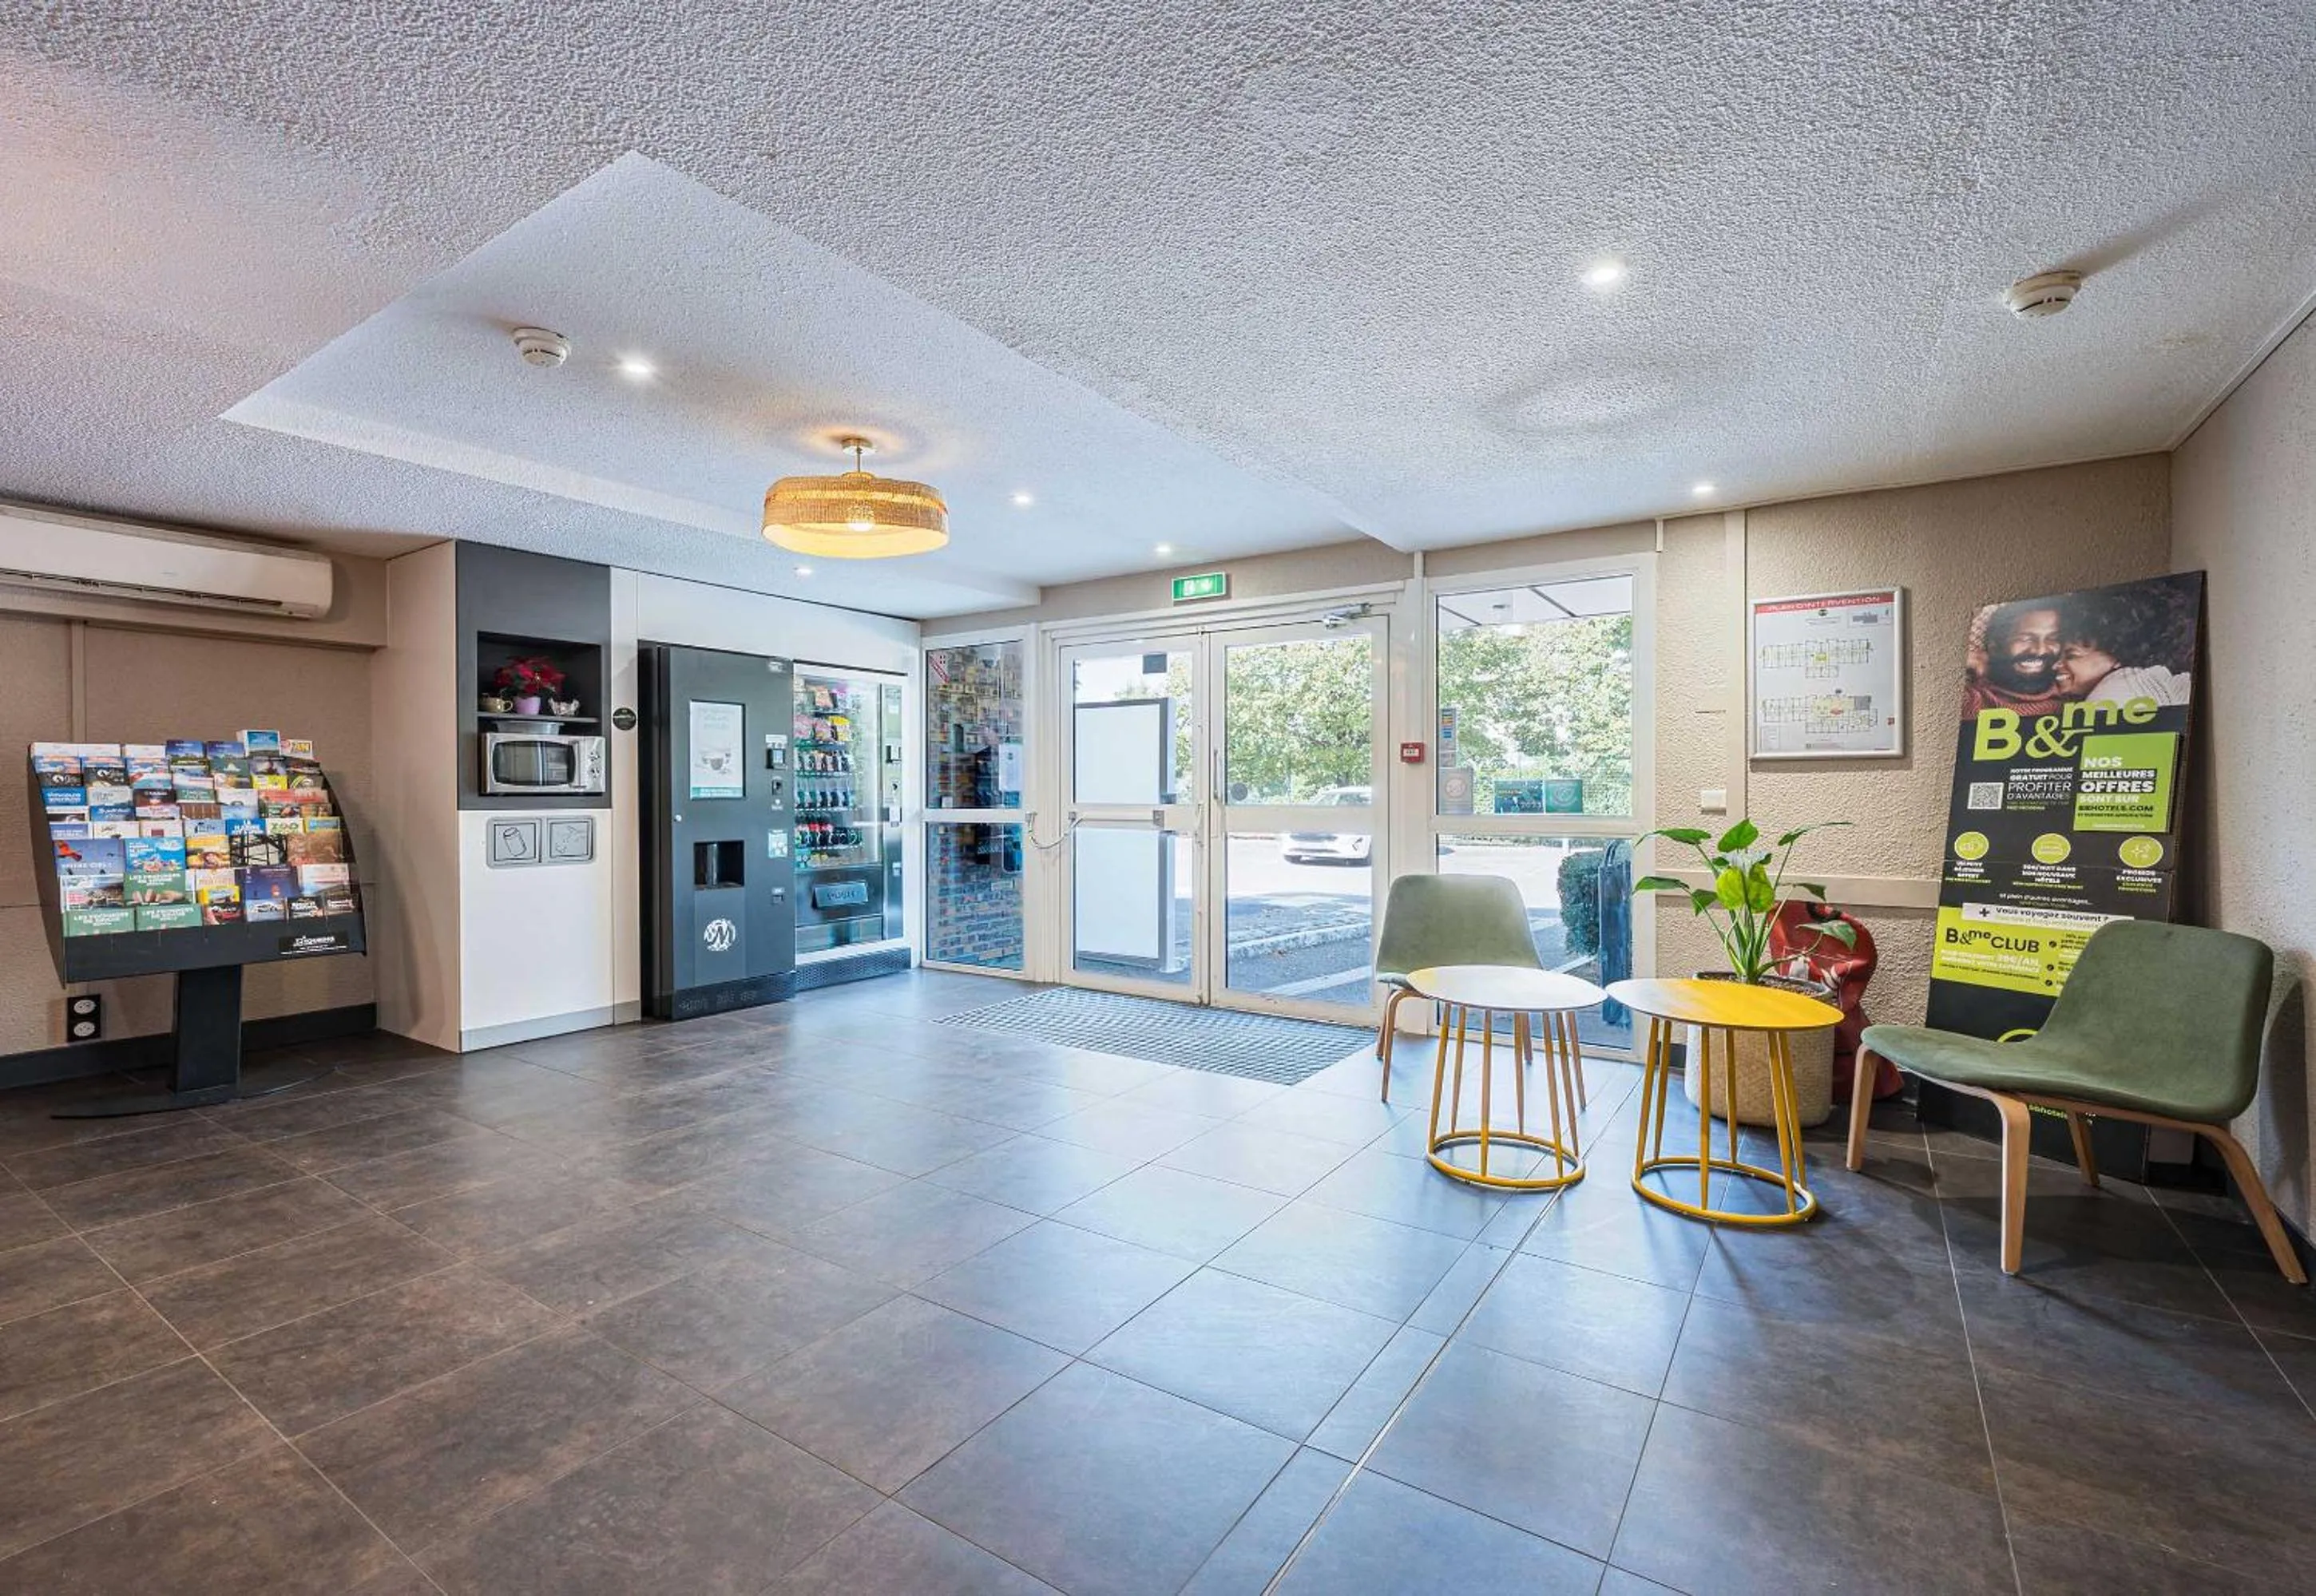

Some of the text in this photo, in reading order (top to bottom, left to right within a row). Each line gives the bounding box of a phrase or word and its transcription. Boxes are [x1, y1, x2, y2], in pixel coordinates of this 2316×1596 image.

[2083, 756, 2123, 768] NOS
[2081, 769, 2155, 779] MEILLEURES
[2008, 782, 2072, 792] PROFITER
[2080, 780, 2155, 793] OFFRES
[2116, 875, 2163, 884] EXCLUSIVES
[2021, 910, 2059, 920] voyagez
[2060, 913, 2101, 922] souvent
